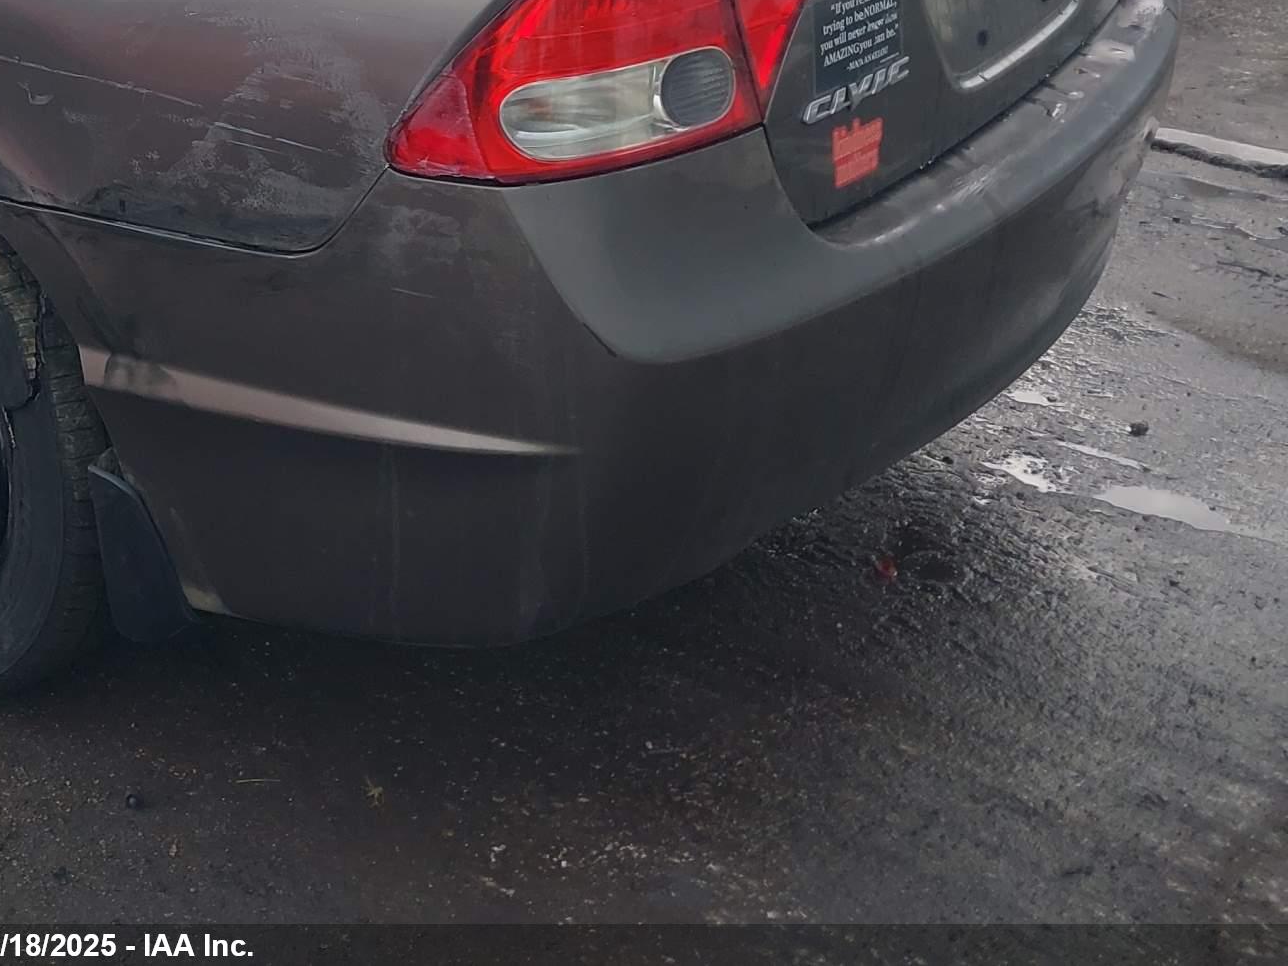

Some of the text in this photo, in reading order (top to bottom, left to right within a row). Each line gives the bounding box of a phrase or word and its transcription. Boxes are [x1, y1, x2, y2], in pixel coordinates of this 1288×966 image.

[823, 19, 845, 36] trying
[846, 16, 853, 25] to
[854, 10, 864, 22] be
[820, 40, 834, 55] you
[834, 31, 847, 45] will
[823, 42, 859, 67] AMAZING
[858, 39, 872, 54] you
[802, 56, 910, 124] CIVIC
